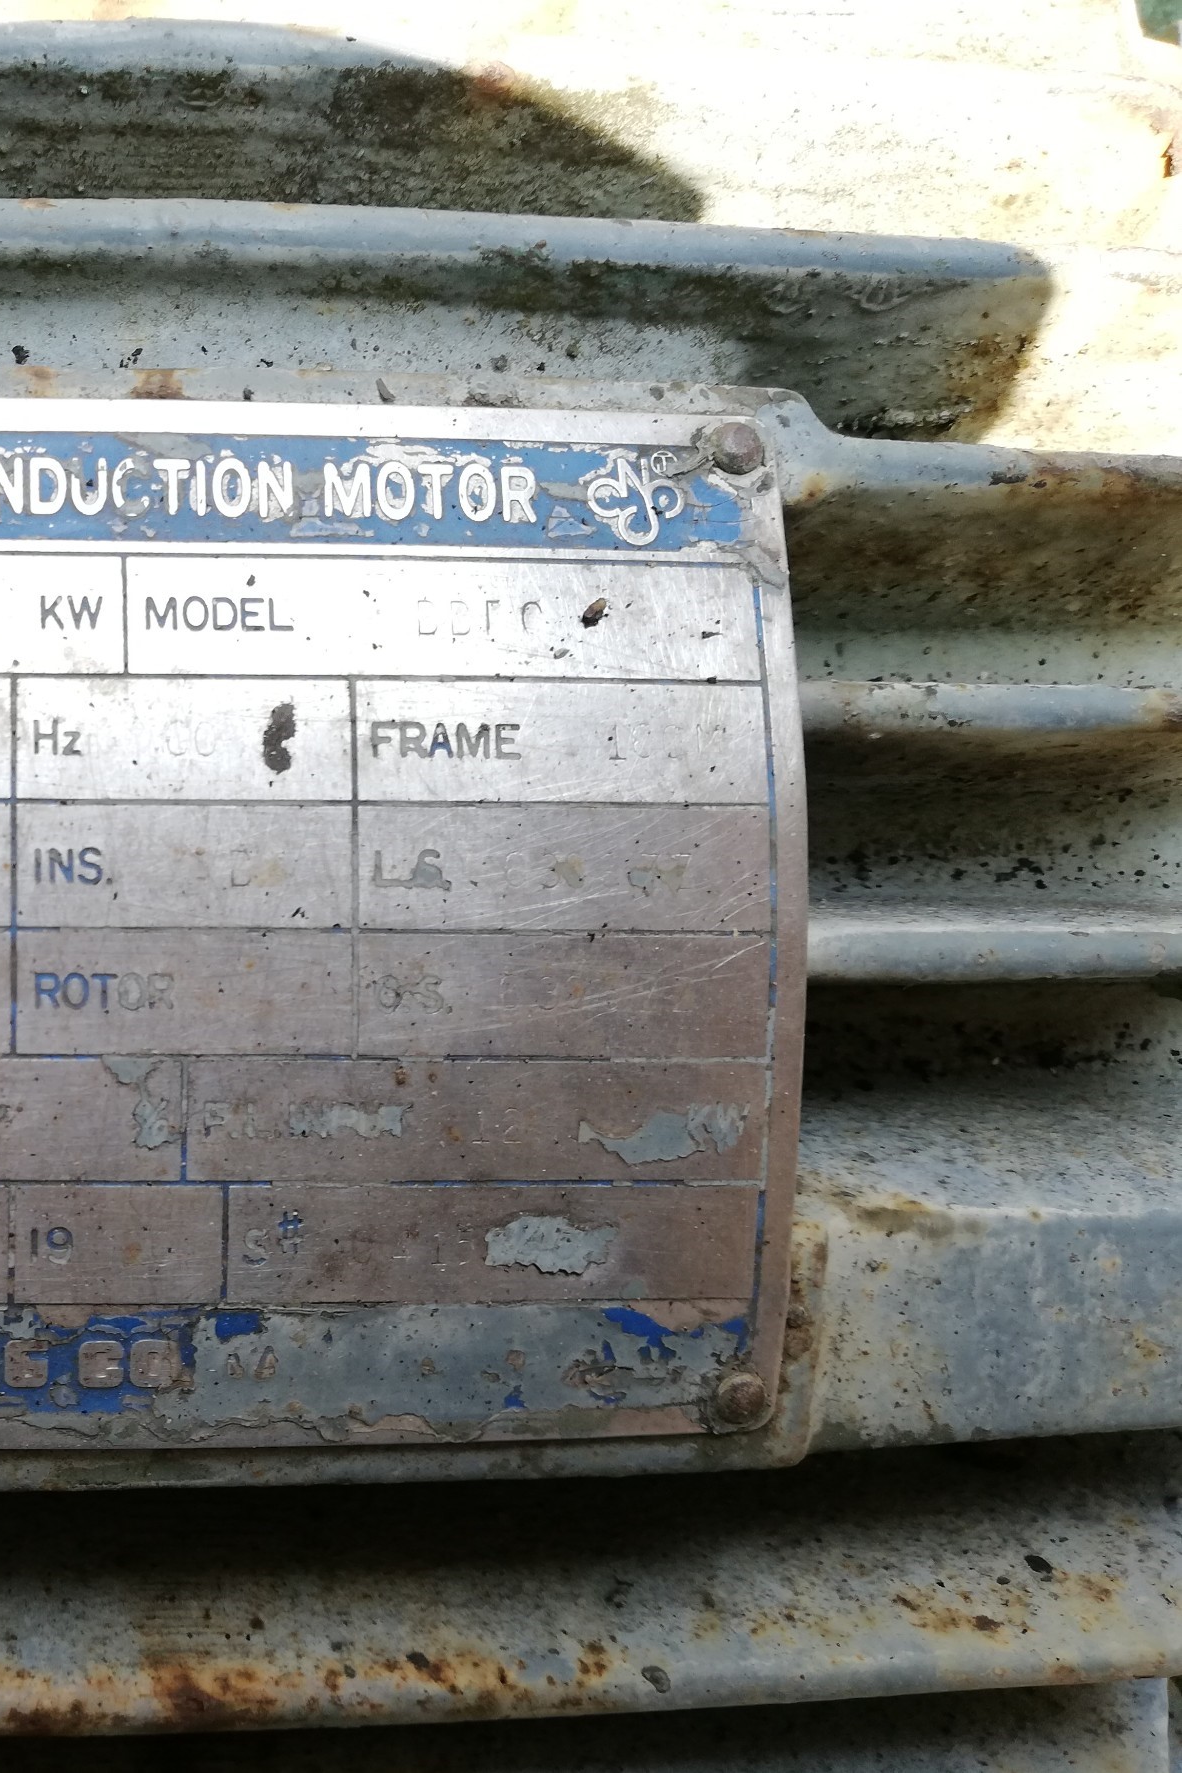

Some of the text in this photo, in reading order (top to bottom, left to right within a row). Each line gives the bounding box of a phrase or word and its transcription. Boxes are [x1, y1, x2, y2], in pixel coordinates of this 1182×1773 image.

[323, 466, 537, 524] MOTOR
[39, 595, 104, 630] KW
[144, 596, 295, 631] MODEL
[33, 719, 82, 756] Hz
[371, 721, 522, 760] FRAME
[33, 846, 113, 885] INS.
[33, 972, 174, 1010] ROTOR
[29, 1226, 73, 1266] 19
